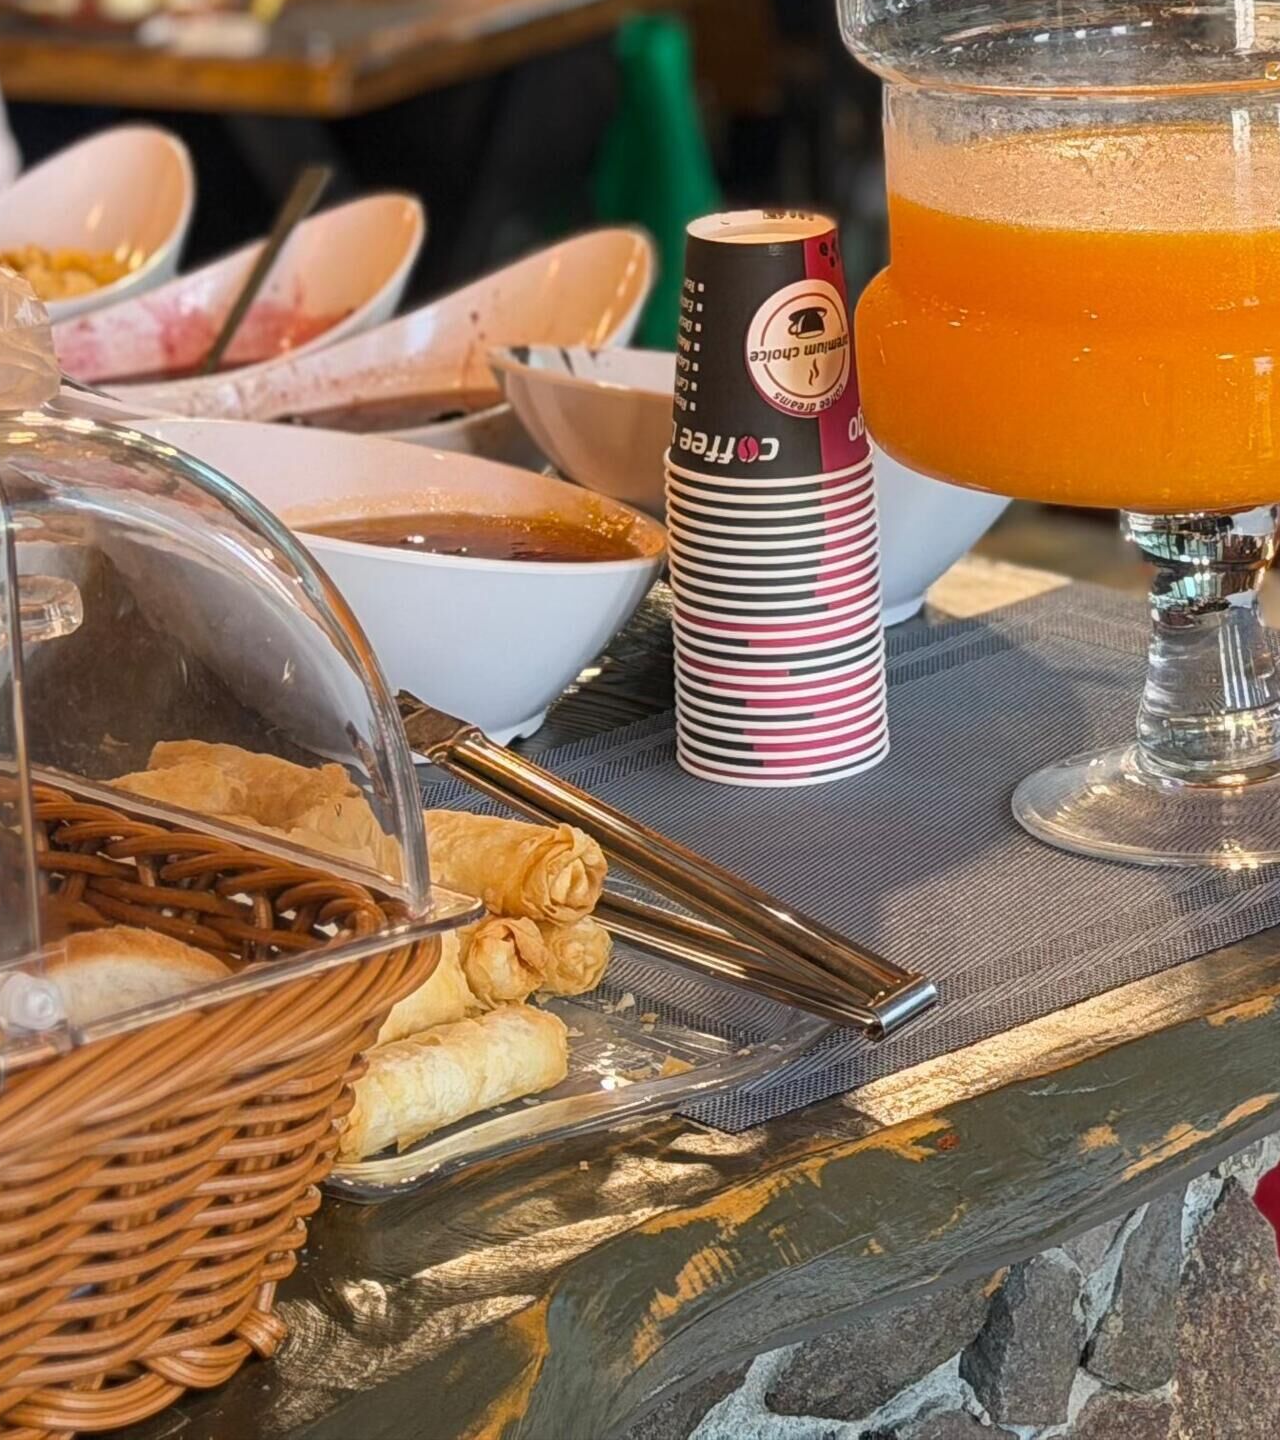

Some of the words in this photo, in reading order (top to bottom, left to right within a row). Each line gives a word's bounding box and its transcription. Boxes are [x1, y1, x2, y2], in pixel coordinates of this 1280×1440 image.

[749, 348, 800, 363] choice
[773, 391, 817, 412] dreams
[820, 383, 844, 407] coffee
[679, 427, 780, 465] coffee
